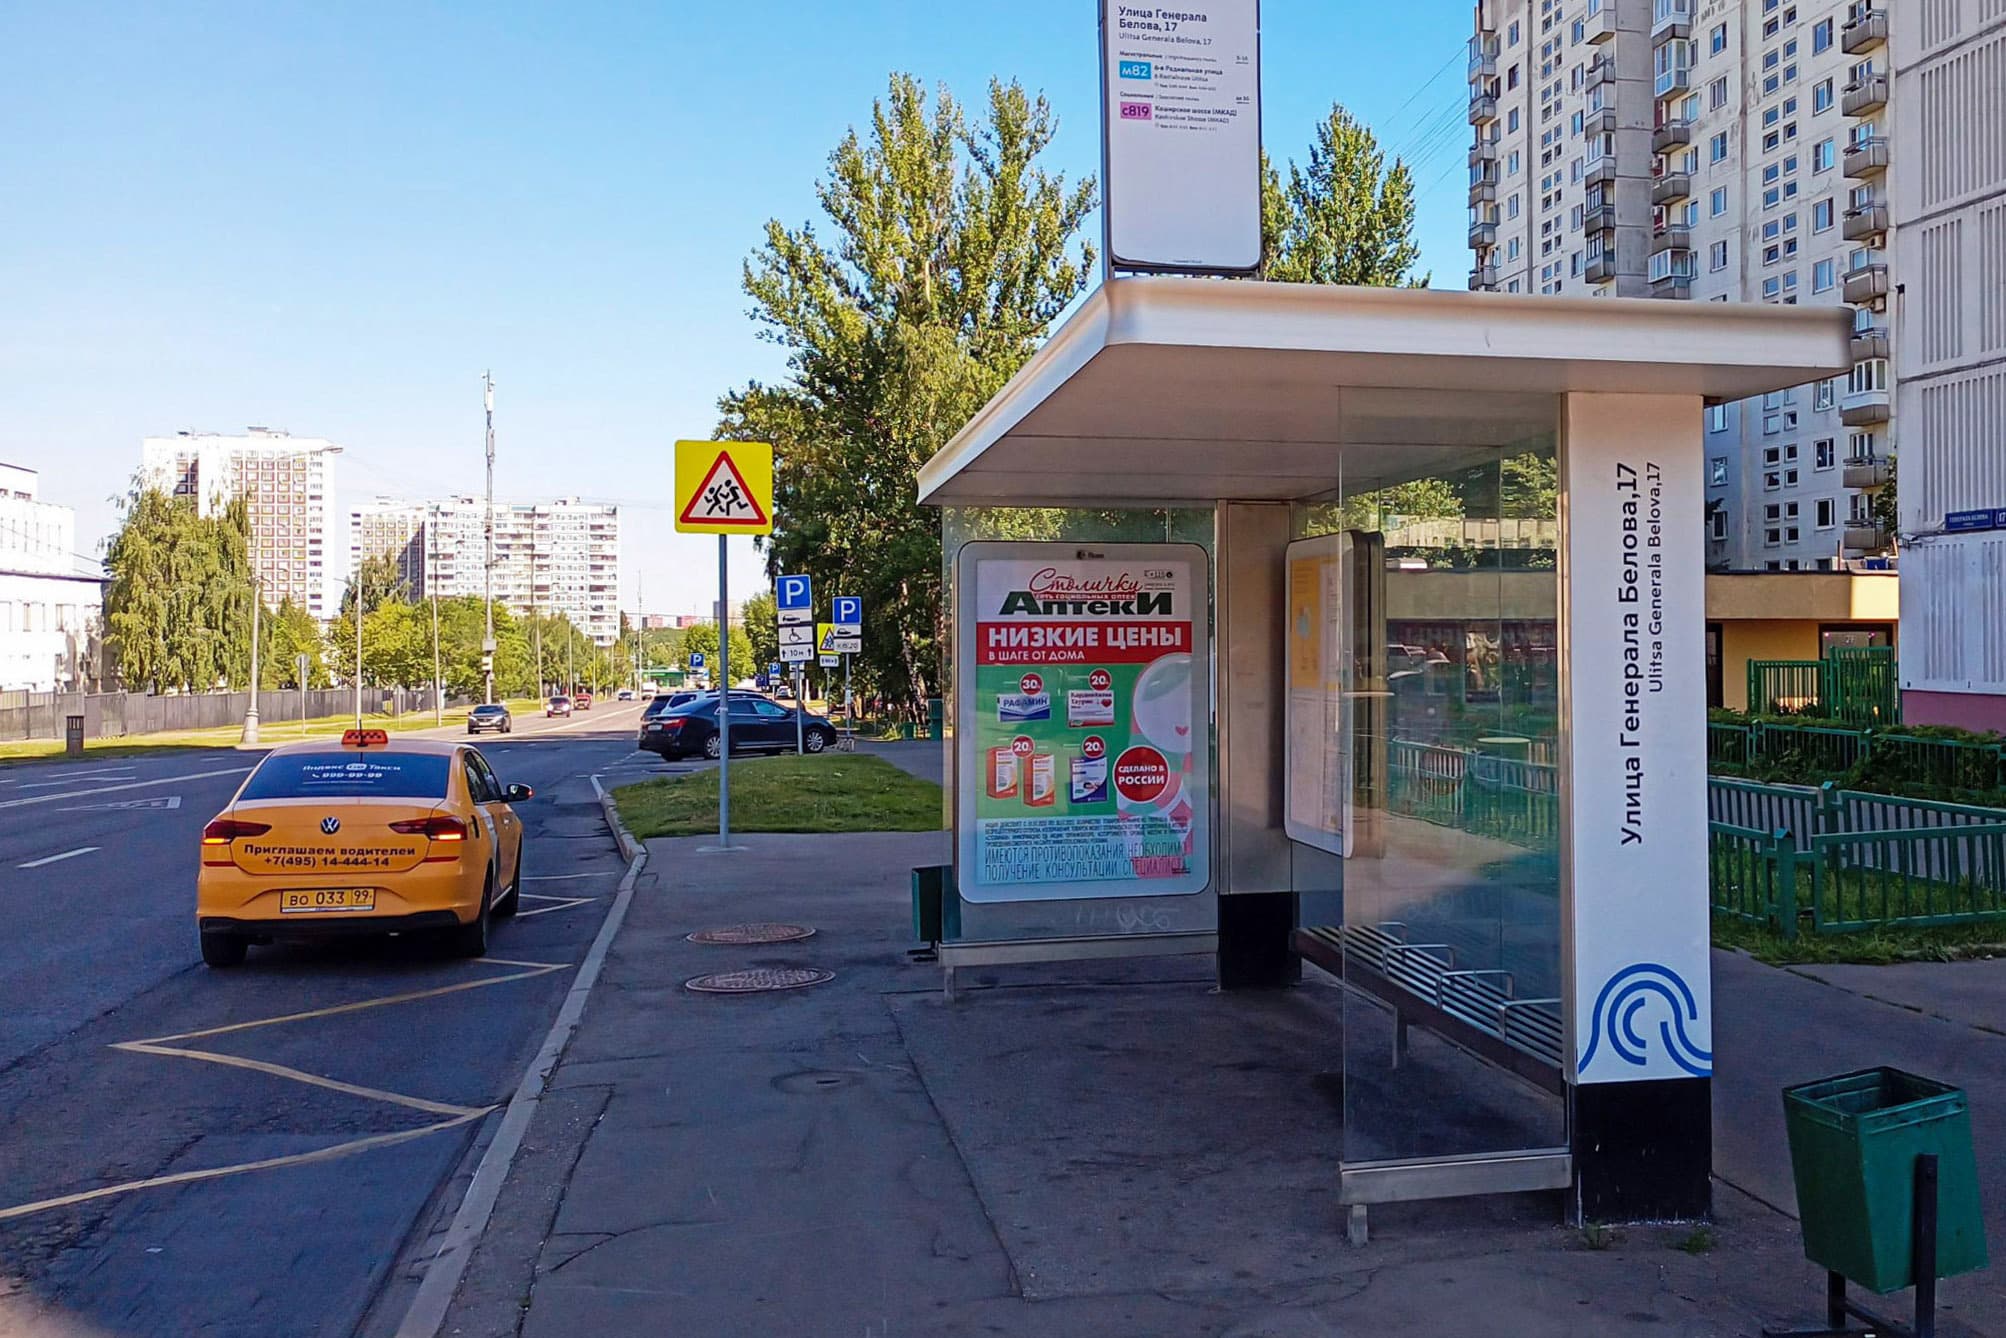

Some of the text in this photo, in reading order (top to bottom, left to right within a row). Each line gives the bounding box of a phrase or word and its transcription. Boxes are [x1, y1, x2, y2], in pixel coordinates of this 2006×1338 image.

[1119, 5, 1207, 22] Улица Генерала
[1119, 18, 1178, 32] Белова, 17
[1122, 65, 1148, 77] м82
[1029, 567, 1143, 592] Столички
[786, 580, 804, 605] P
[1647, 553, 1662, 635] Generala
[840, 600, 856, 621] P
[988, 627, 1182, 650] НИЗКИЕ ЦЕНЫ
[693, 655, 701, 664] P
[988, 651, 1085, 661] В ШАГЕ ОТ ДОМА
[1648, 641, 1663, 692] Ulitsa
[1620, 613, 1644, 746] Генерала
[1118, 765, 1157, 773] СДЕЛАНО
[1118, 775, 1165, 785] РОССИИ
[1621, 757, 1644, 845] Улица
[244, 844, 416, 857] Приглашаем водителей
[985, 847, 1030, 864] ИМЕЮТСЯ
[1031, 842, 1124, 863] ПРОТИВОПОКАЗАНИЯ
[264, 856, 390, 868] +7(495) 14-444-14
[985, 863, 1040, 881] ПОЛУЧЕНИЕ
[1046, 860, 1119, 879] КОНСУЛЬТАЦИИ
[316, 891, 345, 905] 033
